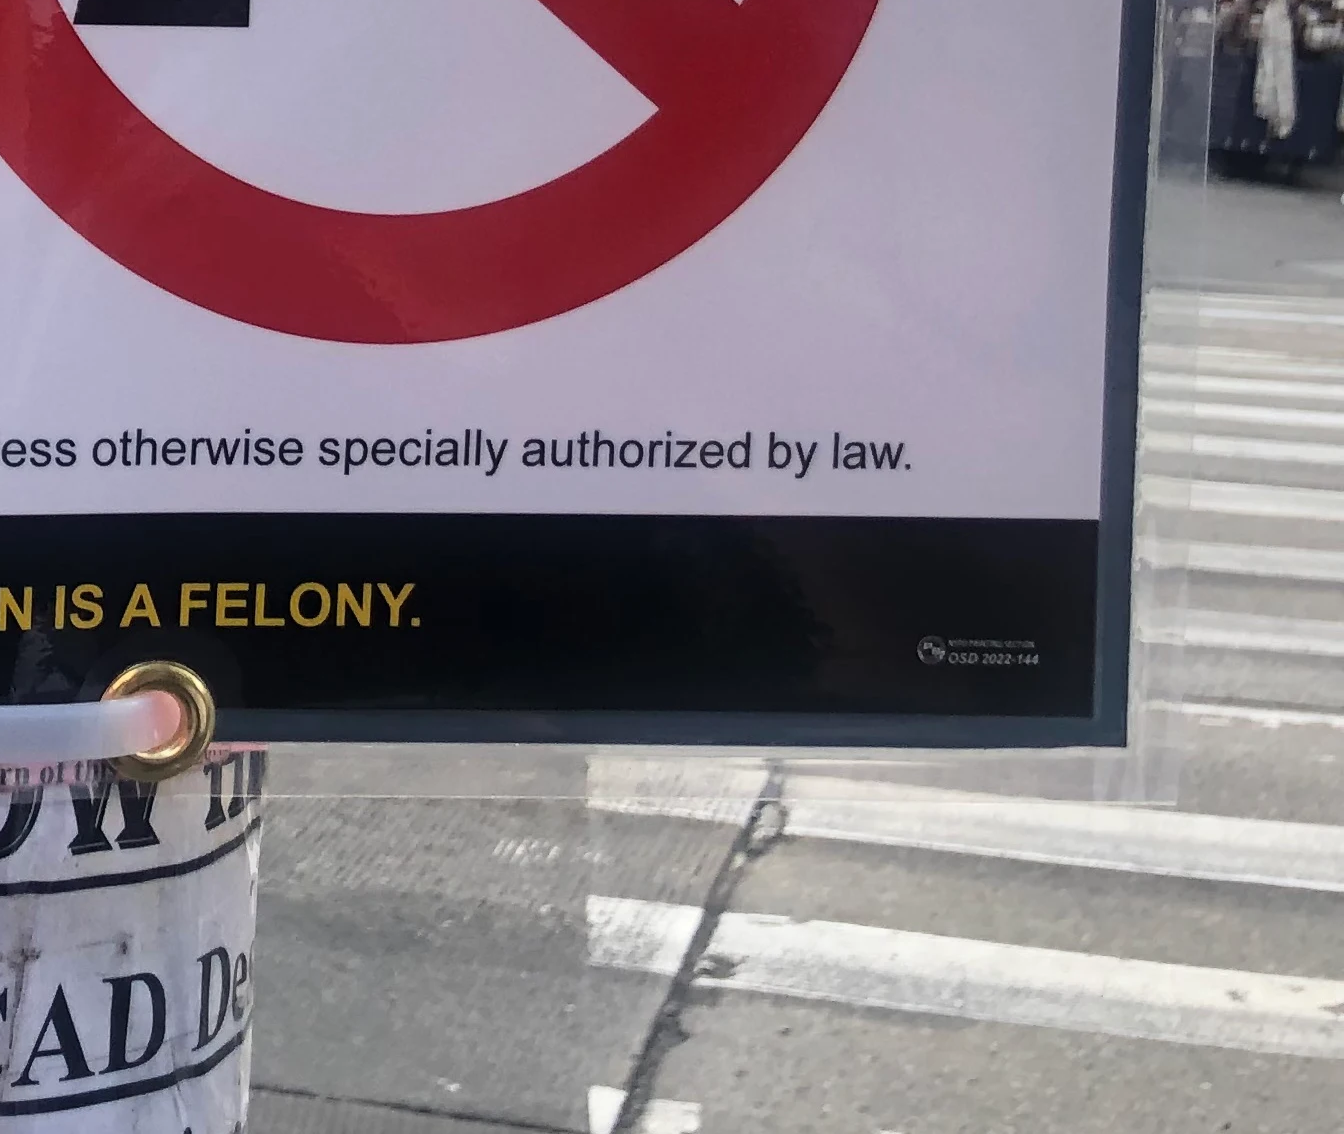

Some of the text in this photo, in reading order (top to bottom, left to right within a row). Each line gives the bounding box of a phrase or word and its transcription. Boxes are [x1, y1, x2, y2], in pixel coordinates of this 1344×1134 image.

[92, 428, 304, 467] otherwise
[318, 428, 509, 477] specially
[521, 431, 752, 469] authorized
[769, 431, 818, 479] by
[832, 432, 912, 471] law.
[55, 584, 105, 630] IS
[120, 583, 161, 627] A
[179, 582, 422, 628] FELONY.
[948, 652, 1039, 664] OSD 2022-144
